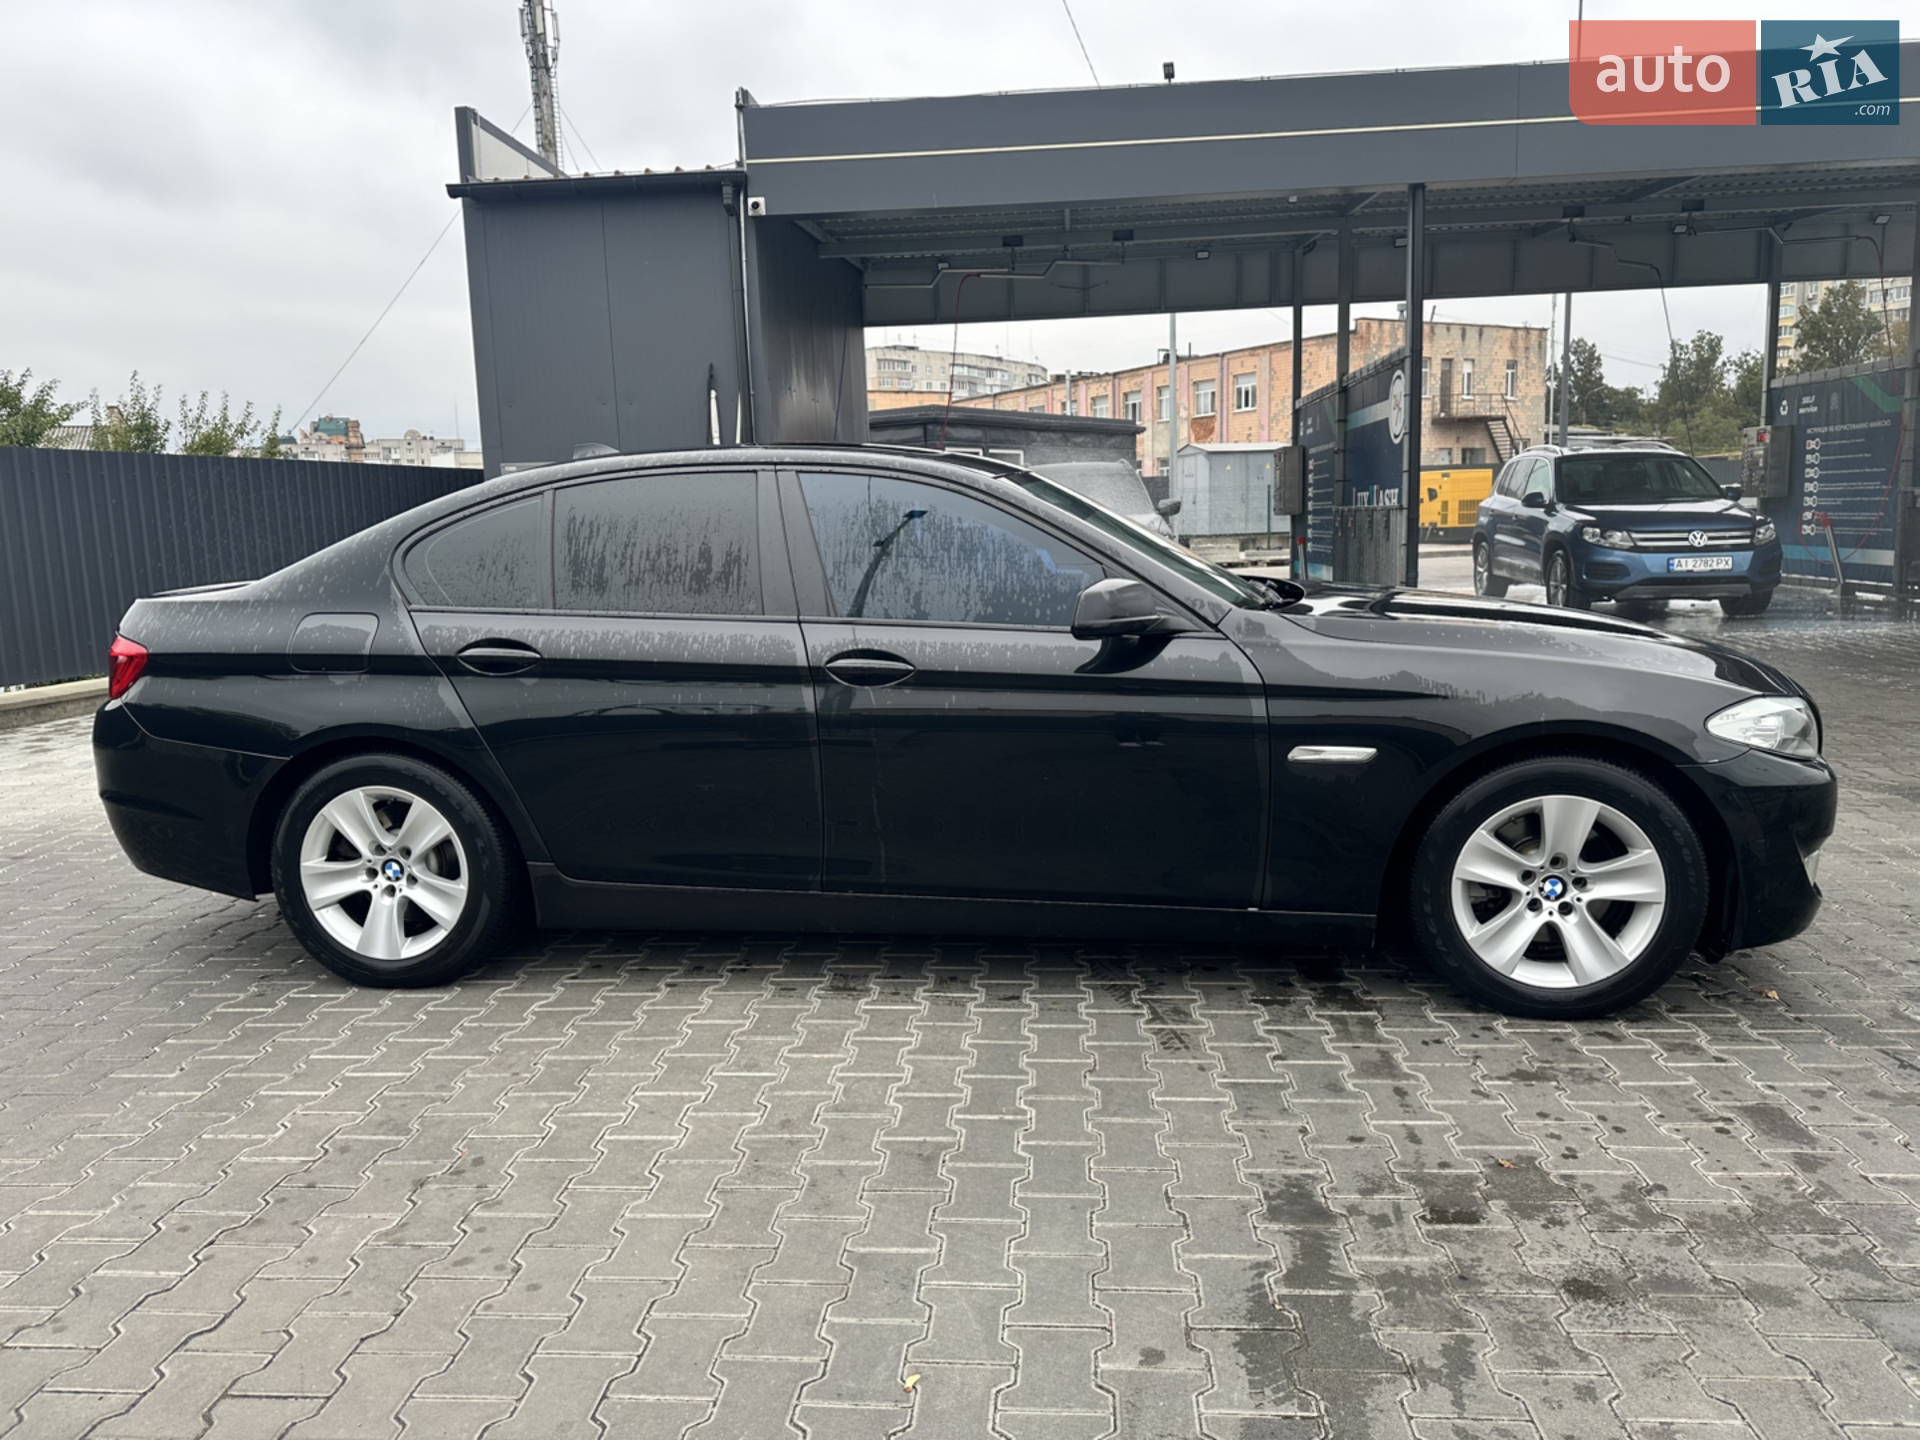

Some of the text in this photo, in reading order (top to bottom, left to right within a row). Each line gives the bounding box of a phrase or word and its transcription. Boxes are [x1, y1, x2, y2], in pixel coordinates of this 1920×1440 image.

[1802, 395, 1816, 405] SELF
[1798, 405, 1818, 415] service
[1692, 558, 1714, 569] 2782
